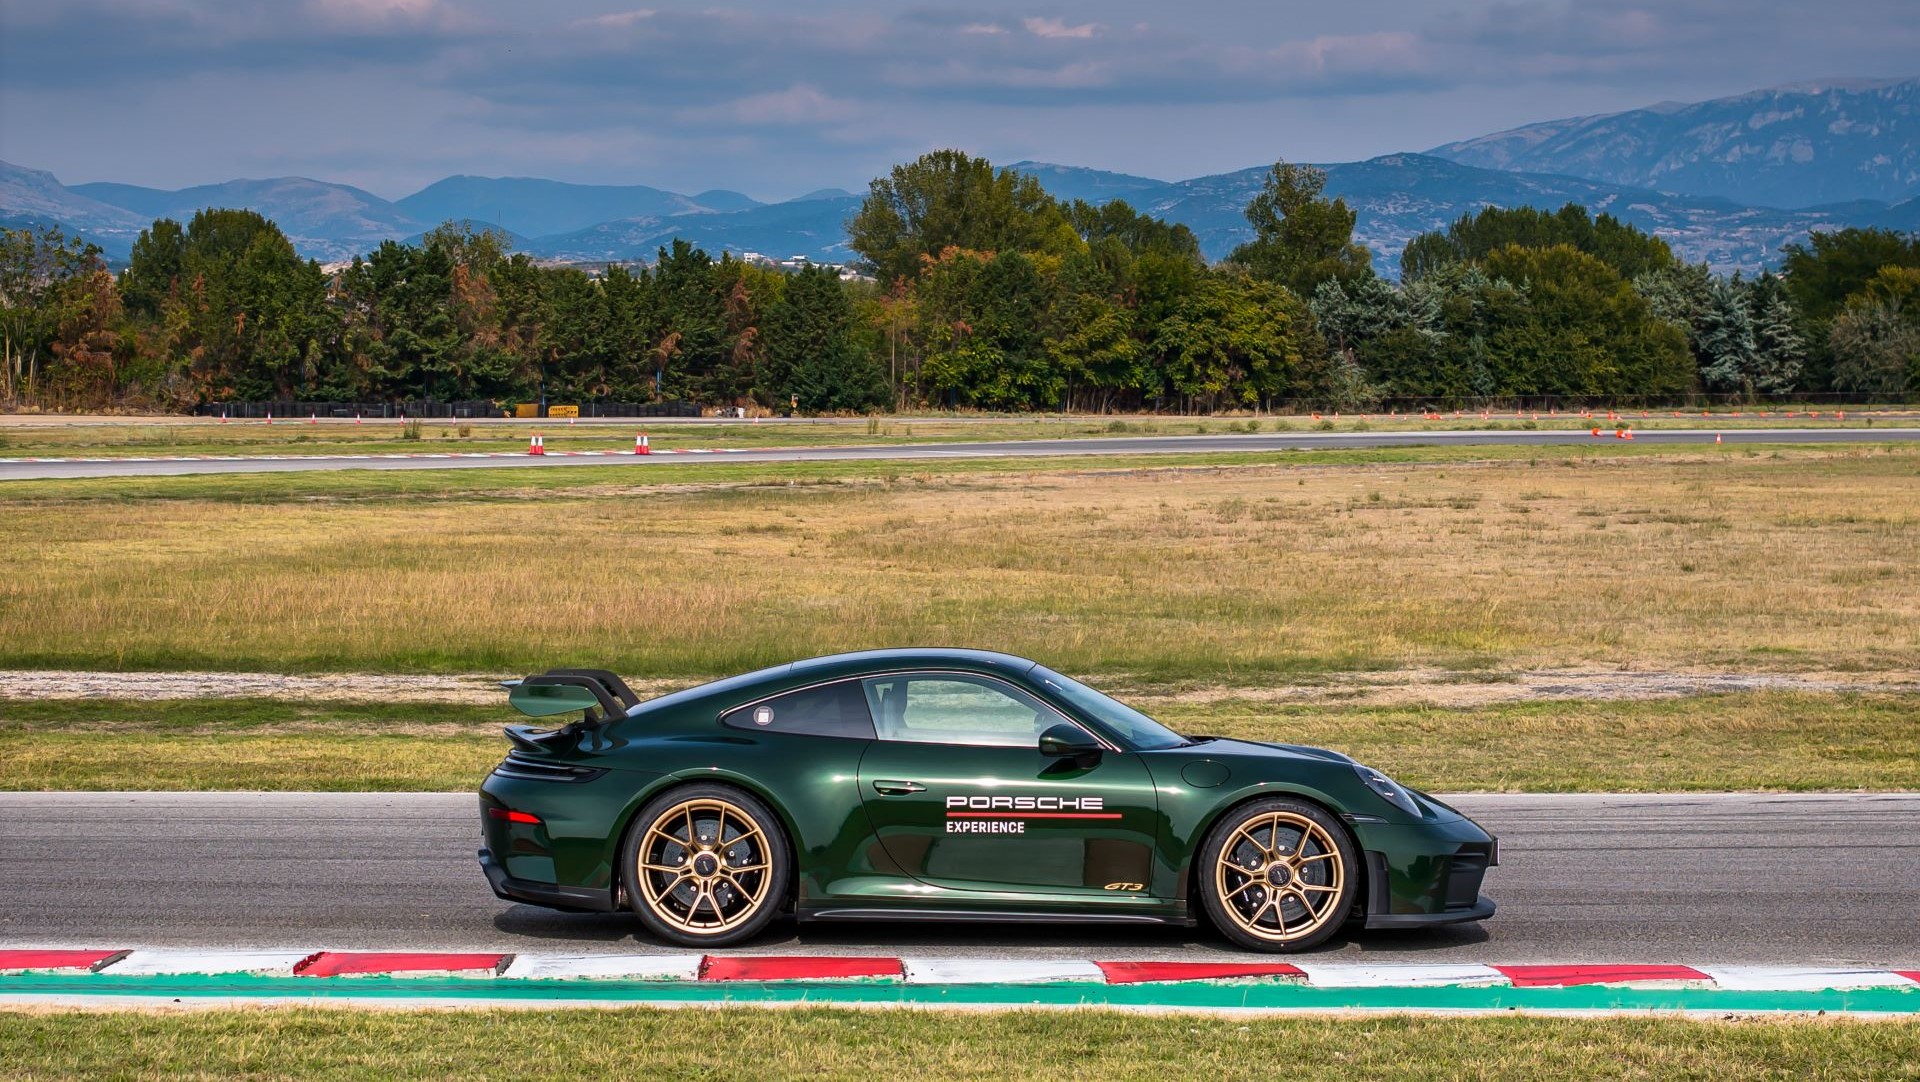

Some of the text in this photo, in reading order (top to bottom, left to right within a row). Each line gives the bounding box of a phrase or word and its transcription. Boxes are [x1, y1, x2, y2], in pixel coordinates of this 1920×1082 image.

[946, 796, 1103, 810] PORSCHE
[946, 821, 1025, 834] EXPERIENCE
[1104, 882, 1144, 891] GT3
